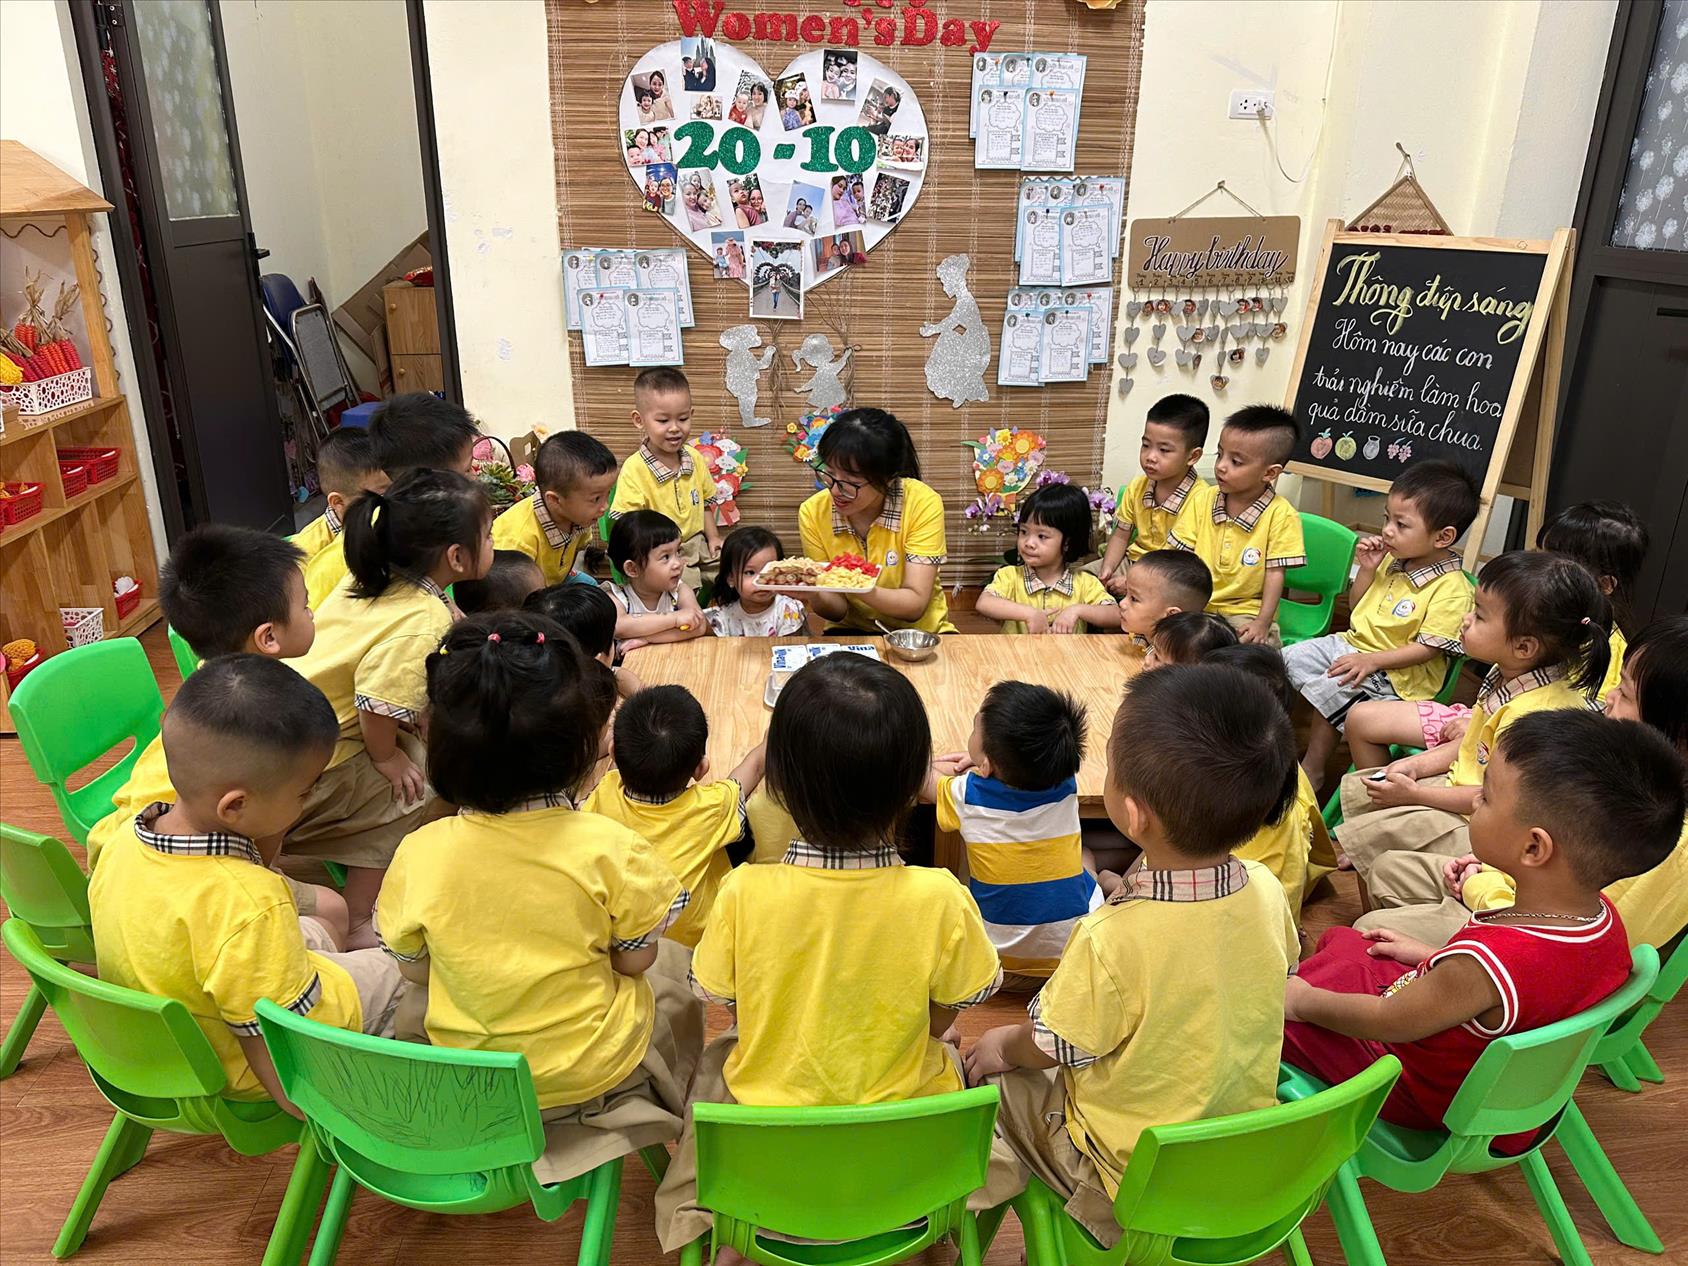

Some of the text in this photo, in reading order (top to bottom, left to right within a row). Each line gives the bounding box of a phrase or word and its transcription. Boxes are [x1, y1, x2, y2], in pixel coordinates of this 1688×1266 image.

[673, 0, 1000, 55] Women's Day
[673, 121, 761, 175] 20
[800, 125, 877, 173] 10
[1143, 235, 1203, 279] Happy
[1205, 234, 1289, 278] birthday
[1332, 251, 1535, 345] Thông điệp sáng
[1332, 318, 1493, 376] Hôm nay các con
[1313, 365, 1502, 418] trải nghiệm làm hoa
[1308, 398, 1341, 425] quả
[1388, 408, 1426, 437] sữa
[1428, 411, 1483, 451] chua.
